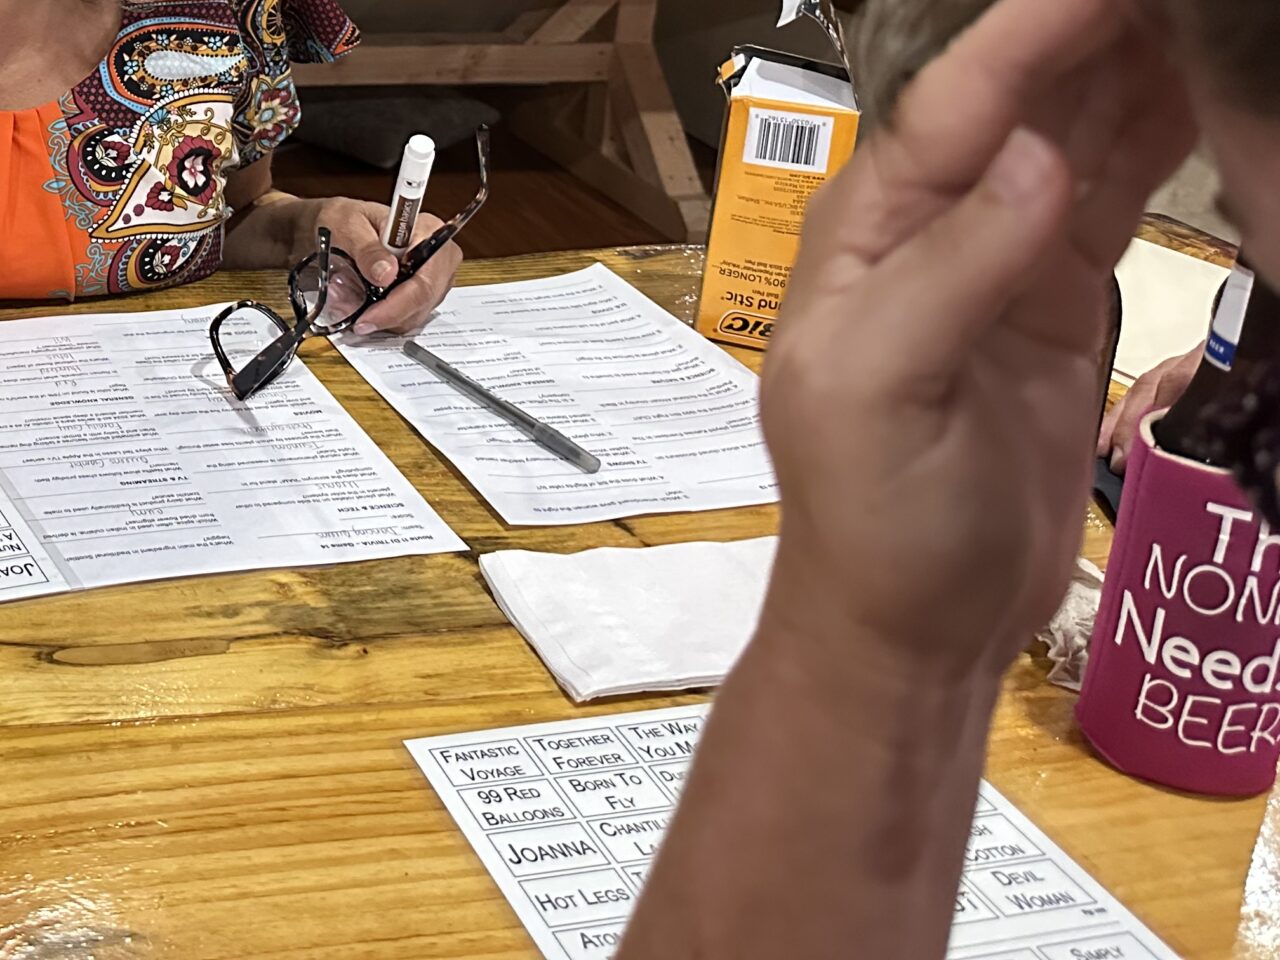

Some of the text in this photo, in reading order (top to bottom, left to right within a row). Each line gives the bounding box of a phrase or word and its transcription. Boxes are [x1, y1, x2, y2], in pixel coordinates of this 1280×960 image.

[763, 276, 786, 289] 90%
[752, 288, 779, 300] Ball Pen
[1, 532, 13, 541] A
[1144, 543, 1280, 625] NON
[1114, 589, 1280, 695] Need
[629, 725, 663, 740] THE
[533, 733, 612, 753] TOGETHER
[637, 744, 675, 760] YOU
[439, 745, 520, 764] FANTASTIC
[552, 753, 626, 771] FOREVER
[461, 765, 526, 782] VOYAGE
[569, 777, 616, 793] BORN
[614, 772, 642, 787] TO
[477, 787, 541, 805] 99 RED
[605, 795, 636, 810] FLY
[481, 806, 565, 827] BALLOONS
[508, 840, 597, 865] JOANNA
[991, 869, 1045, 886] DEVIL
[534, 887, 630, 911] HOT LEGS
[1005, 891, 1076, 910] WOMAN
